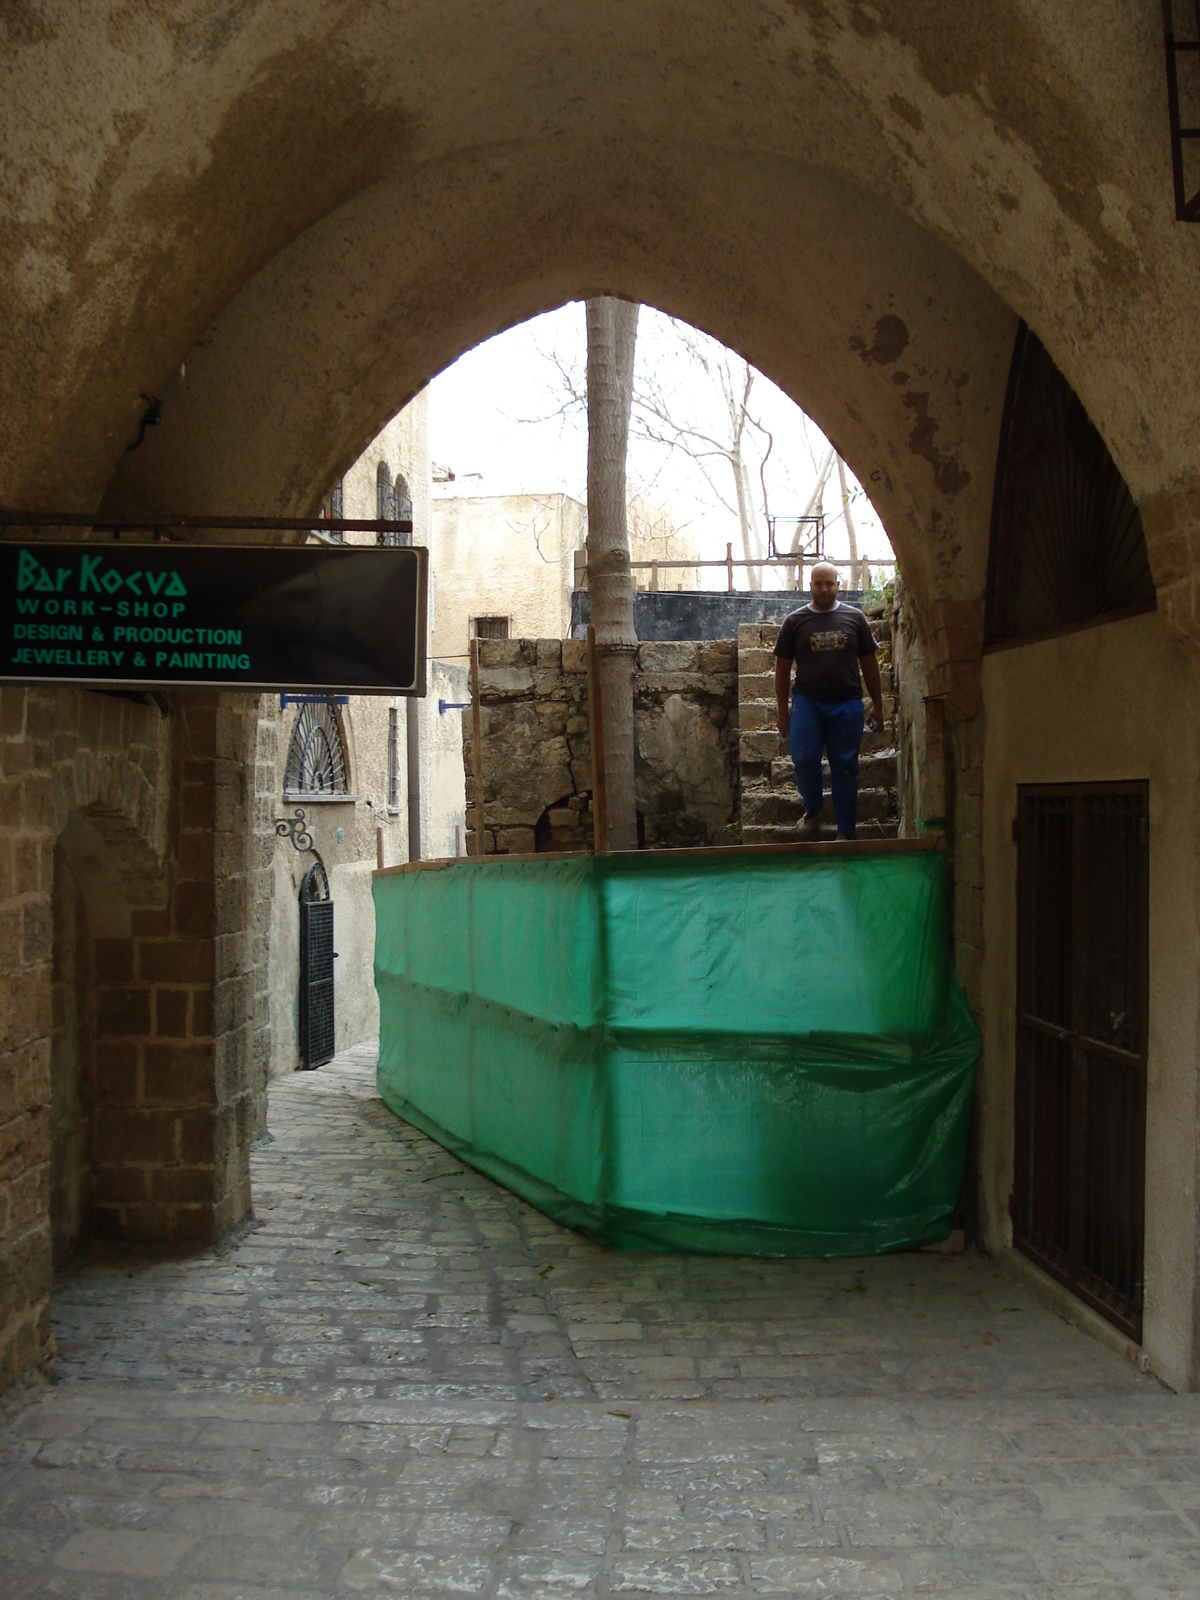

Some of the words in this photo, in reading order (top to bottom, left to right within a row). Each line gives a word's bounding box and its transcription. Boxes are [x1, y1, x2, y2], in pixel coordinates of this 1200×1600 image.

[17, 548, 72, 592] Bar
[13, 623, 83, 641] DESIGN
[91, 626, 104, 642] &
[113, 626, 243, 646] PRODUCTION
[11, 648, 125, 667] JEWELLERY
[133, 651, 146, 667] &
[155, 652, 251, 670] PAINTING
